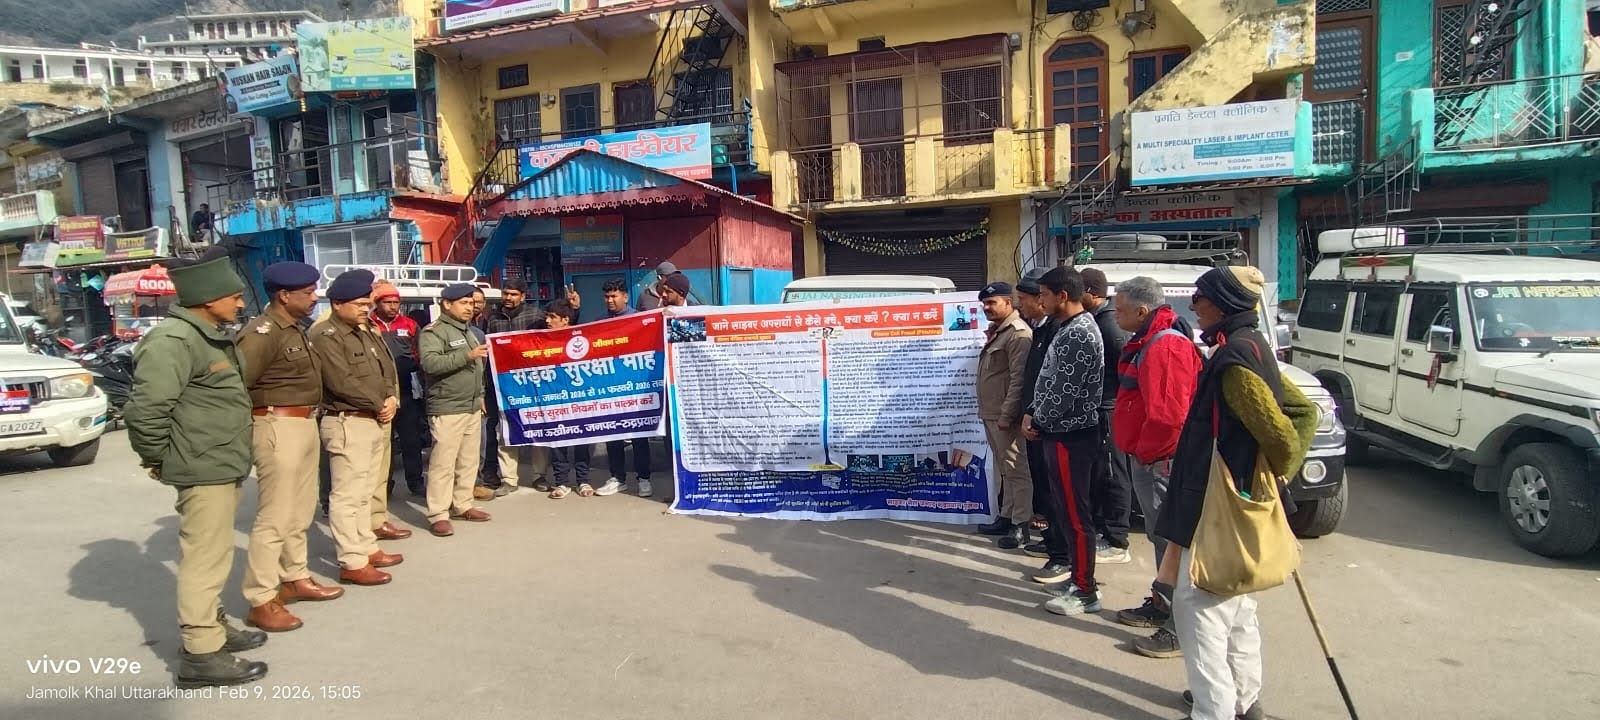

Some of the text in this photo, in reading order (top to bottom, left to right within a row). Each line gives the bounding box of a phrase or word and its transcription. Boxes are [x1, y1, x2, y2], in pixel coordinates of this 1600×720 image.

[255, 69, 271, 81] HAIR
[270, 64, 292, 77] SALON
[1223, 104, 1268, 120] क्लीनिक
[1164, 138, 1202, 148] SPECIALITY
[1204, 136, 1225, 144] LASER
[1234, 133, 1264, 141] IMPLANT
[1150, 206, 1234, 222] अस्पताल
[140, 279, 176, 290] ROOM
[1492, 287, 1522, 298] JAI
[731, 320, 758, 330] साइबर
[794, 314, 802, 327] से
[844, 315, 862, 324] क्या
[882, 310, 890, 322] ?
[892, 312, 910, 322] क्या
[912, 312, 920, 320] न
[510, 350, 656, 387] सड़क सुरक्षा माह
[547, 406, 570, 421] सुरक्षा
[600, 404, 612, 412] का
